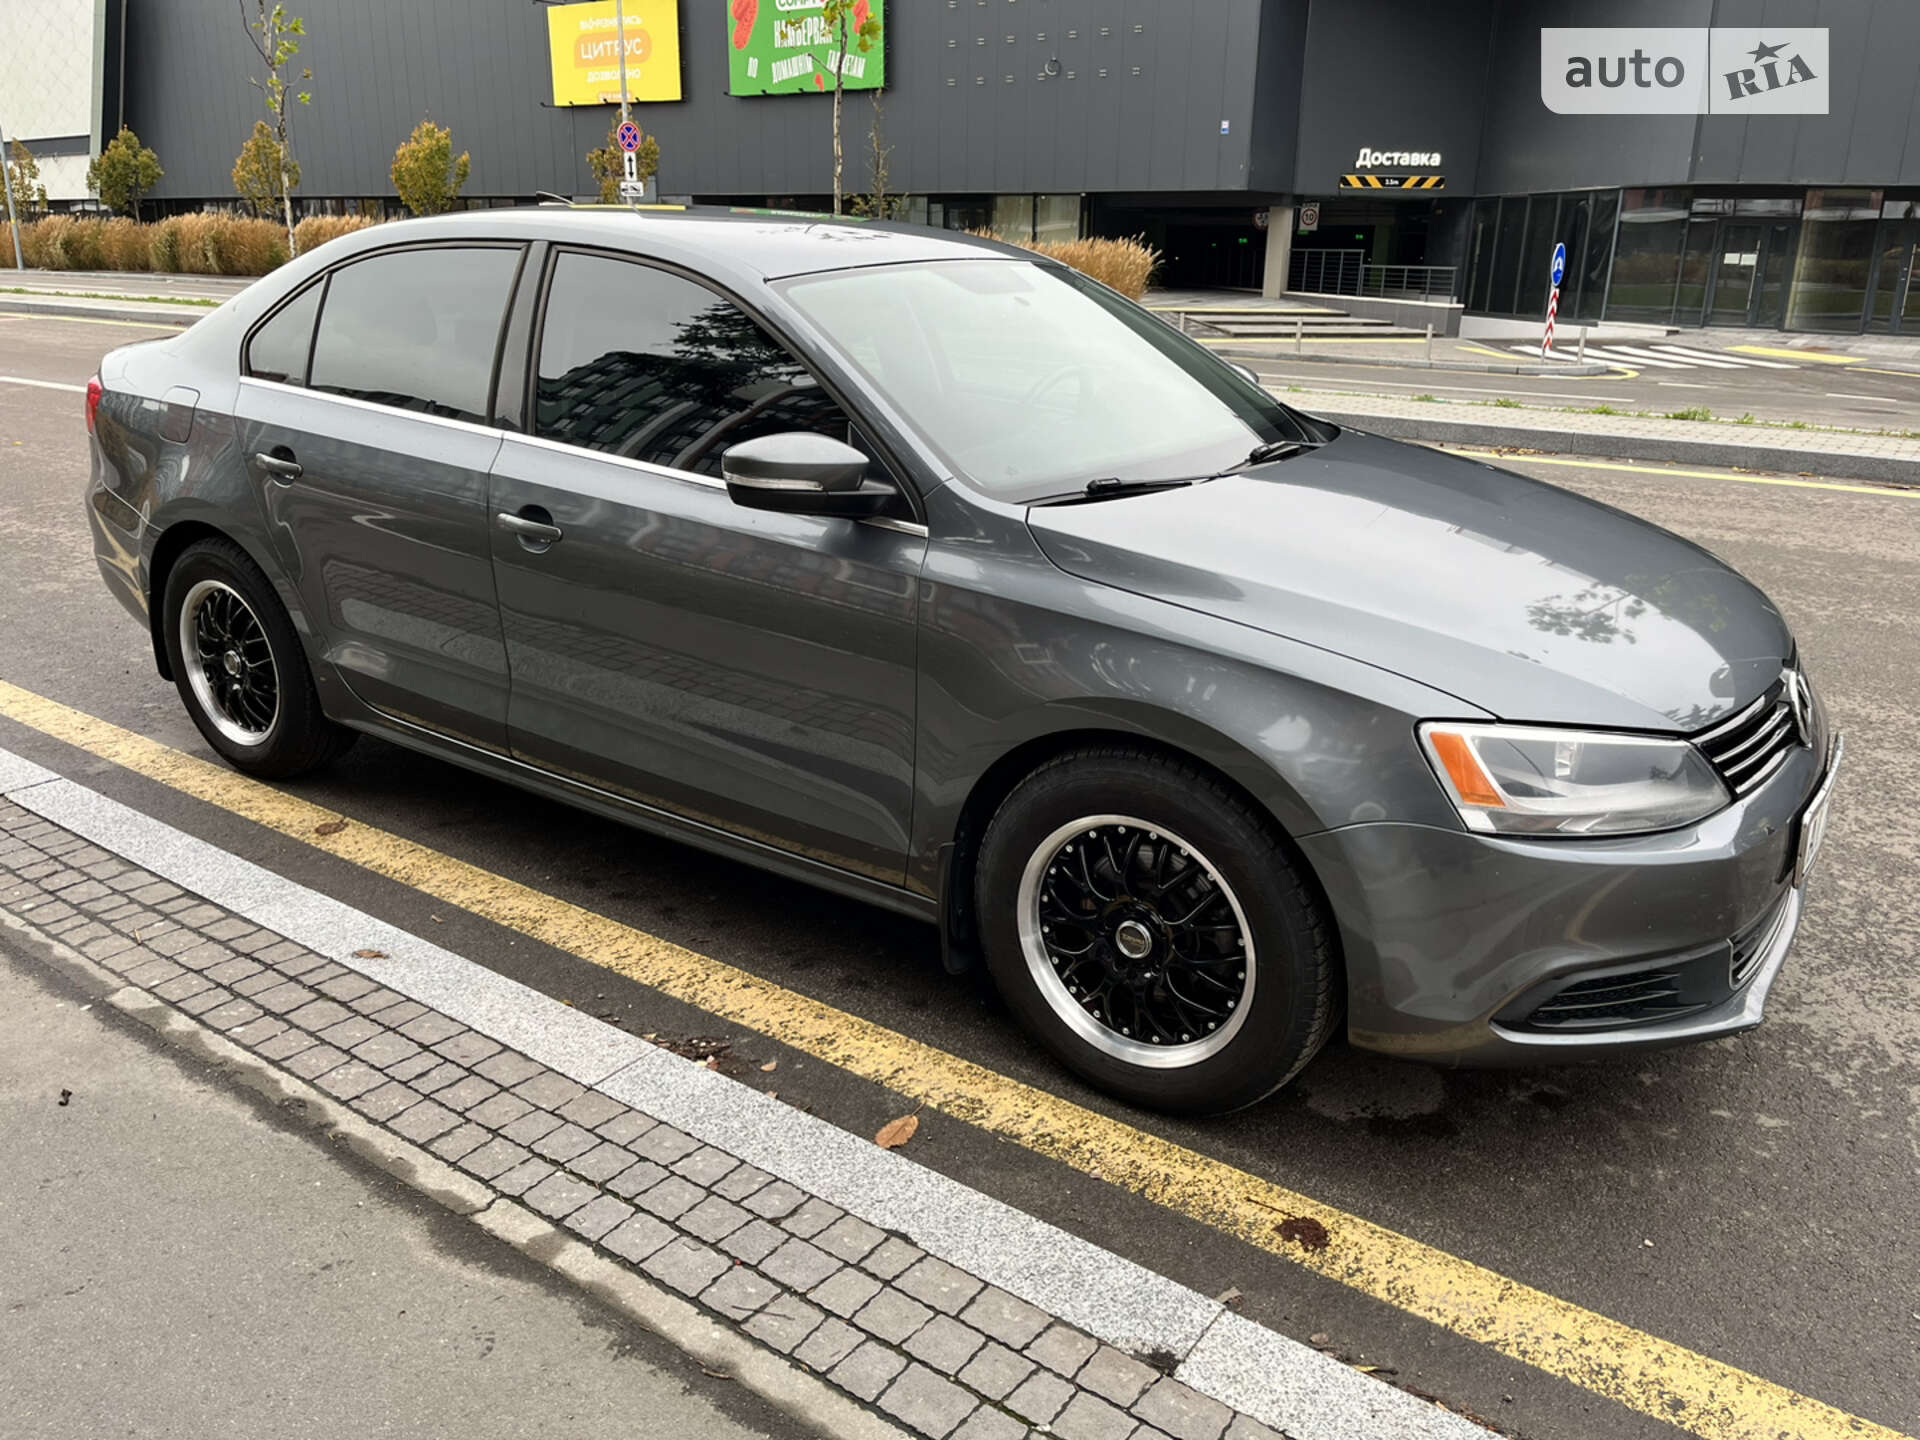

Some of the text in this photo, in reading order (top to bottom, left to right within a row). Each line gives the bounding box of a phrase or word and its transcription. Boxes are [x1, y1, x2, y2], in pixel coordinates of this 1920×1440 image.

[586, 68, 642, 83] ДОЗВОЛНО
[1355, 148, 1442, 169] Доставка
[1304, 212, 1314, 222] 10
